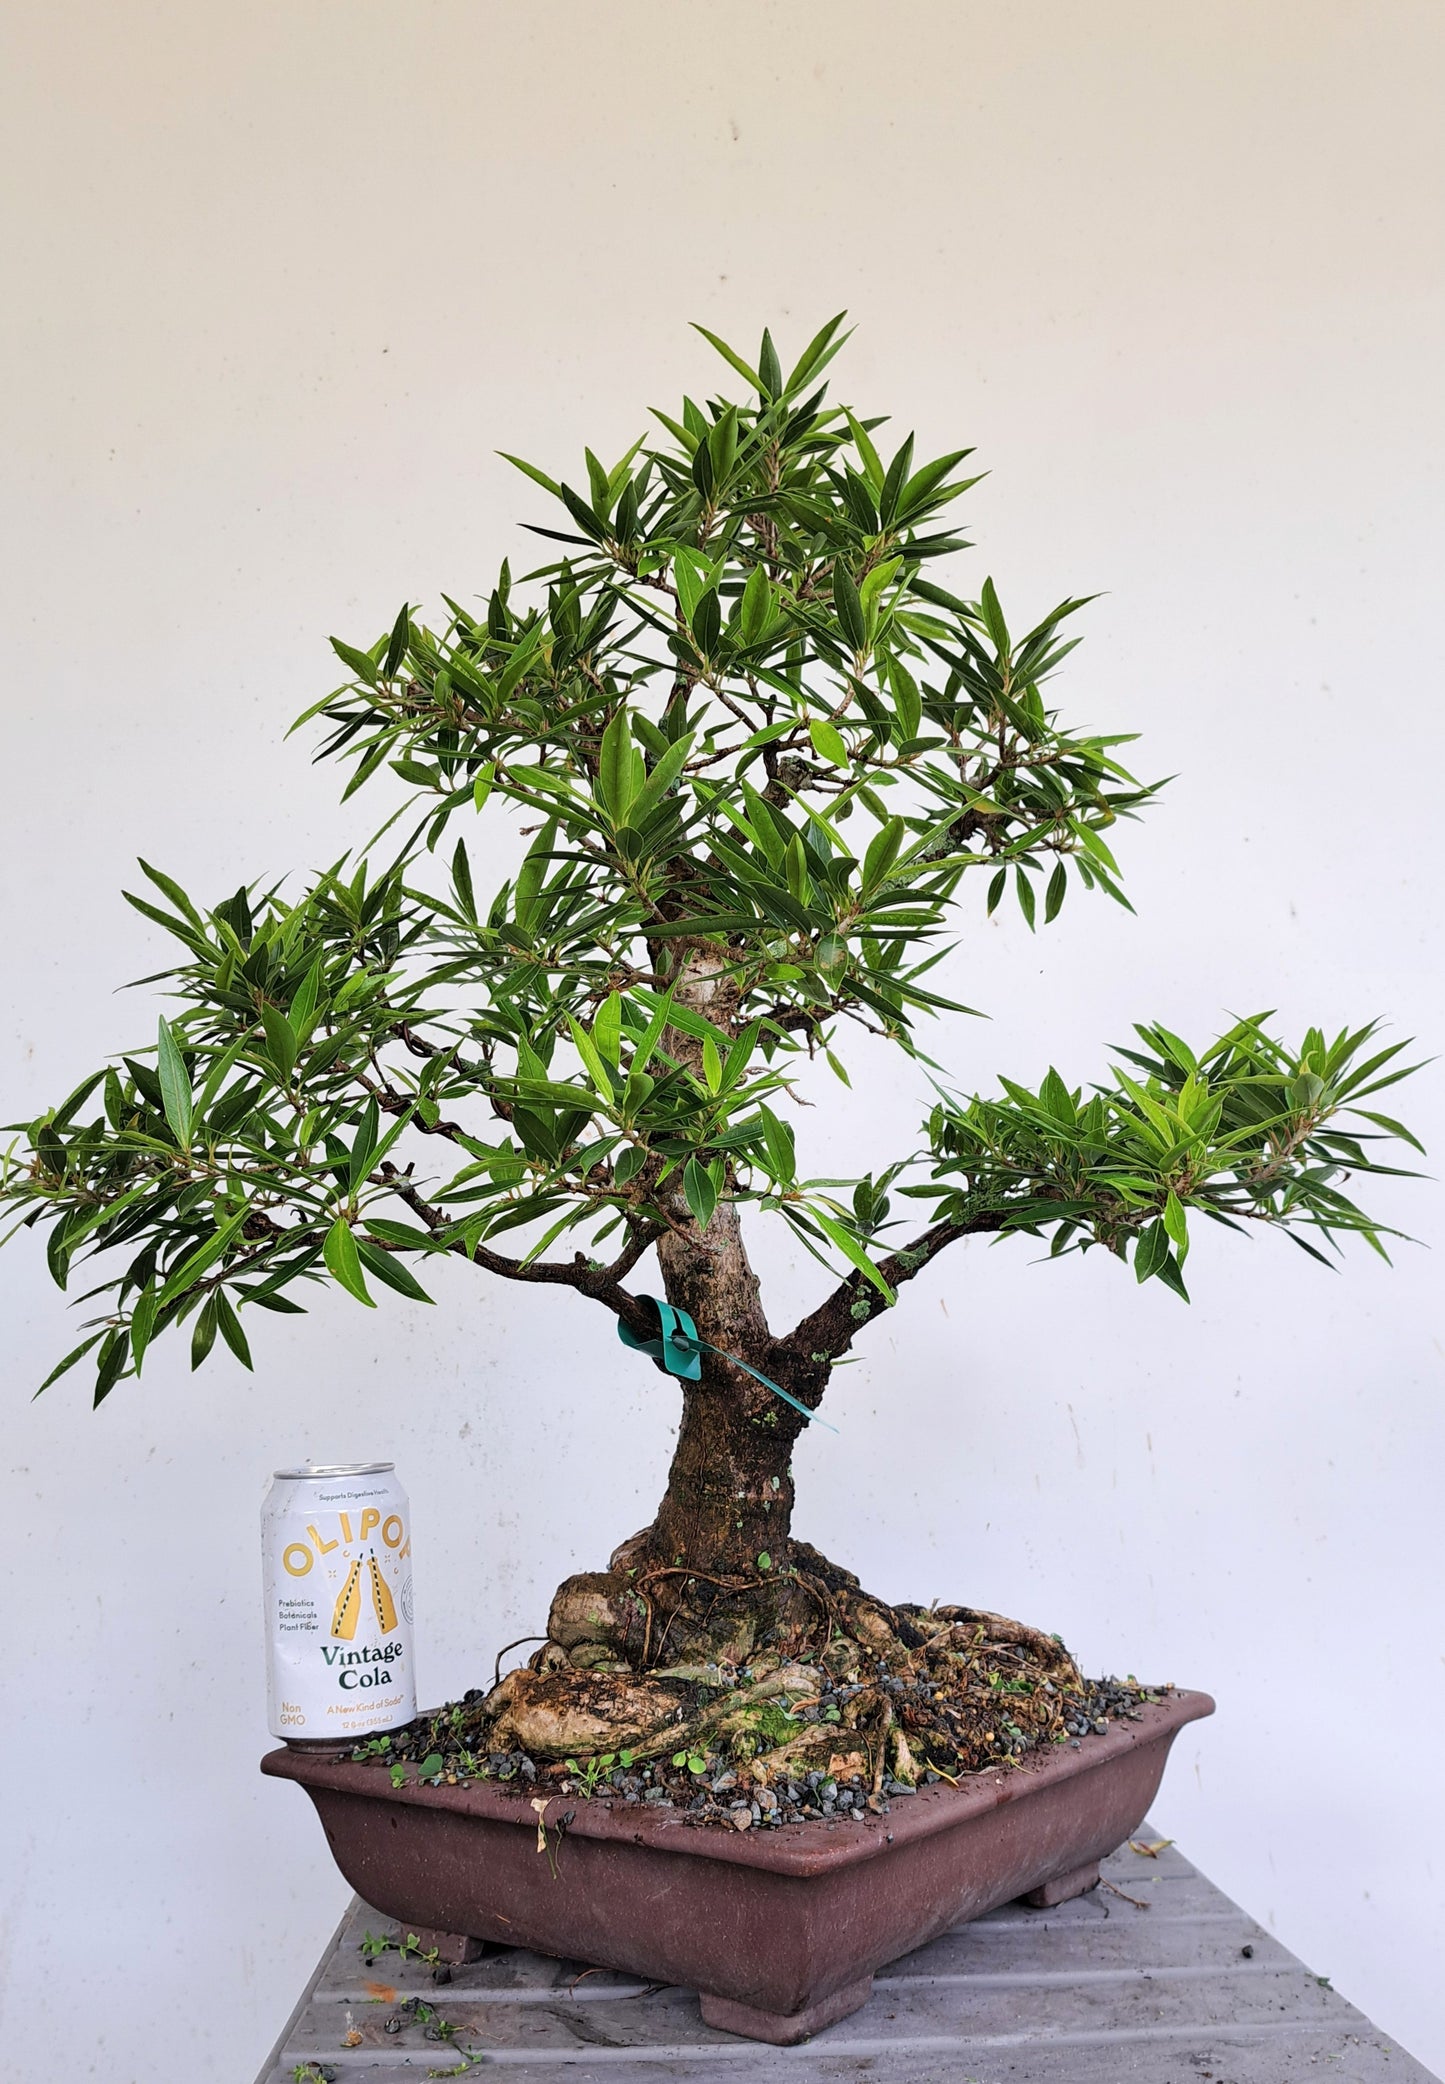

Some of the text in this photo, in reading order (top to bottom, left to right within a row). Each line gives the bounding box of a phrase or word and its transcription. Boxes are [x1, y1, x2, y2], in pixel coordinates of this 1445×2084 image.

[319, 1492, 346, 1501] Supports
[347, 1489, 373, 1499] Digestive
[278, 1599, 314, 1607] Prebiotics
[279, 1611, 317, 1619] Botanicals
[279, 1622, 319, 1631] Plant Fiber
[320, 1641, 403, 1666] Vintage
[338, 1666, 393, 1690] Cola
[282, 1702, 302, 1713] Non
[327, 1705, 335, 1714] A
[335, 1704, 355, 1713] New
[355, 1702, 374, 1711] Kind
[280, 1714, 306, 1726] GMO
